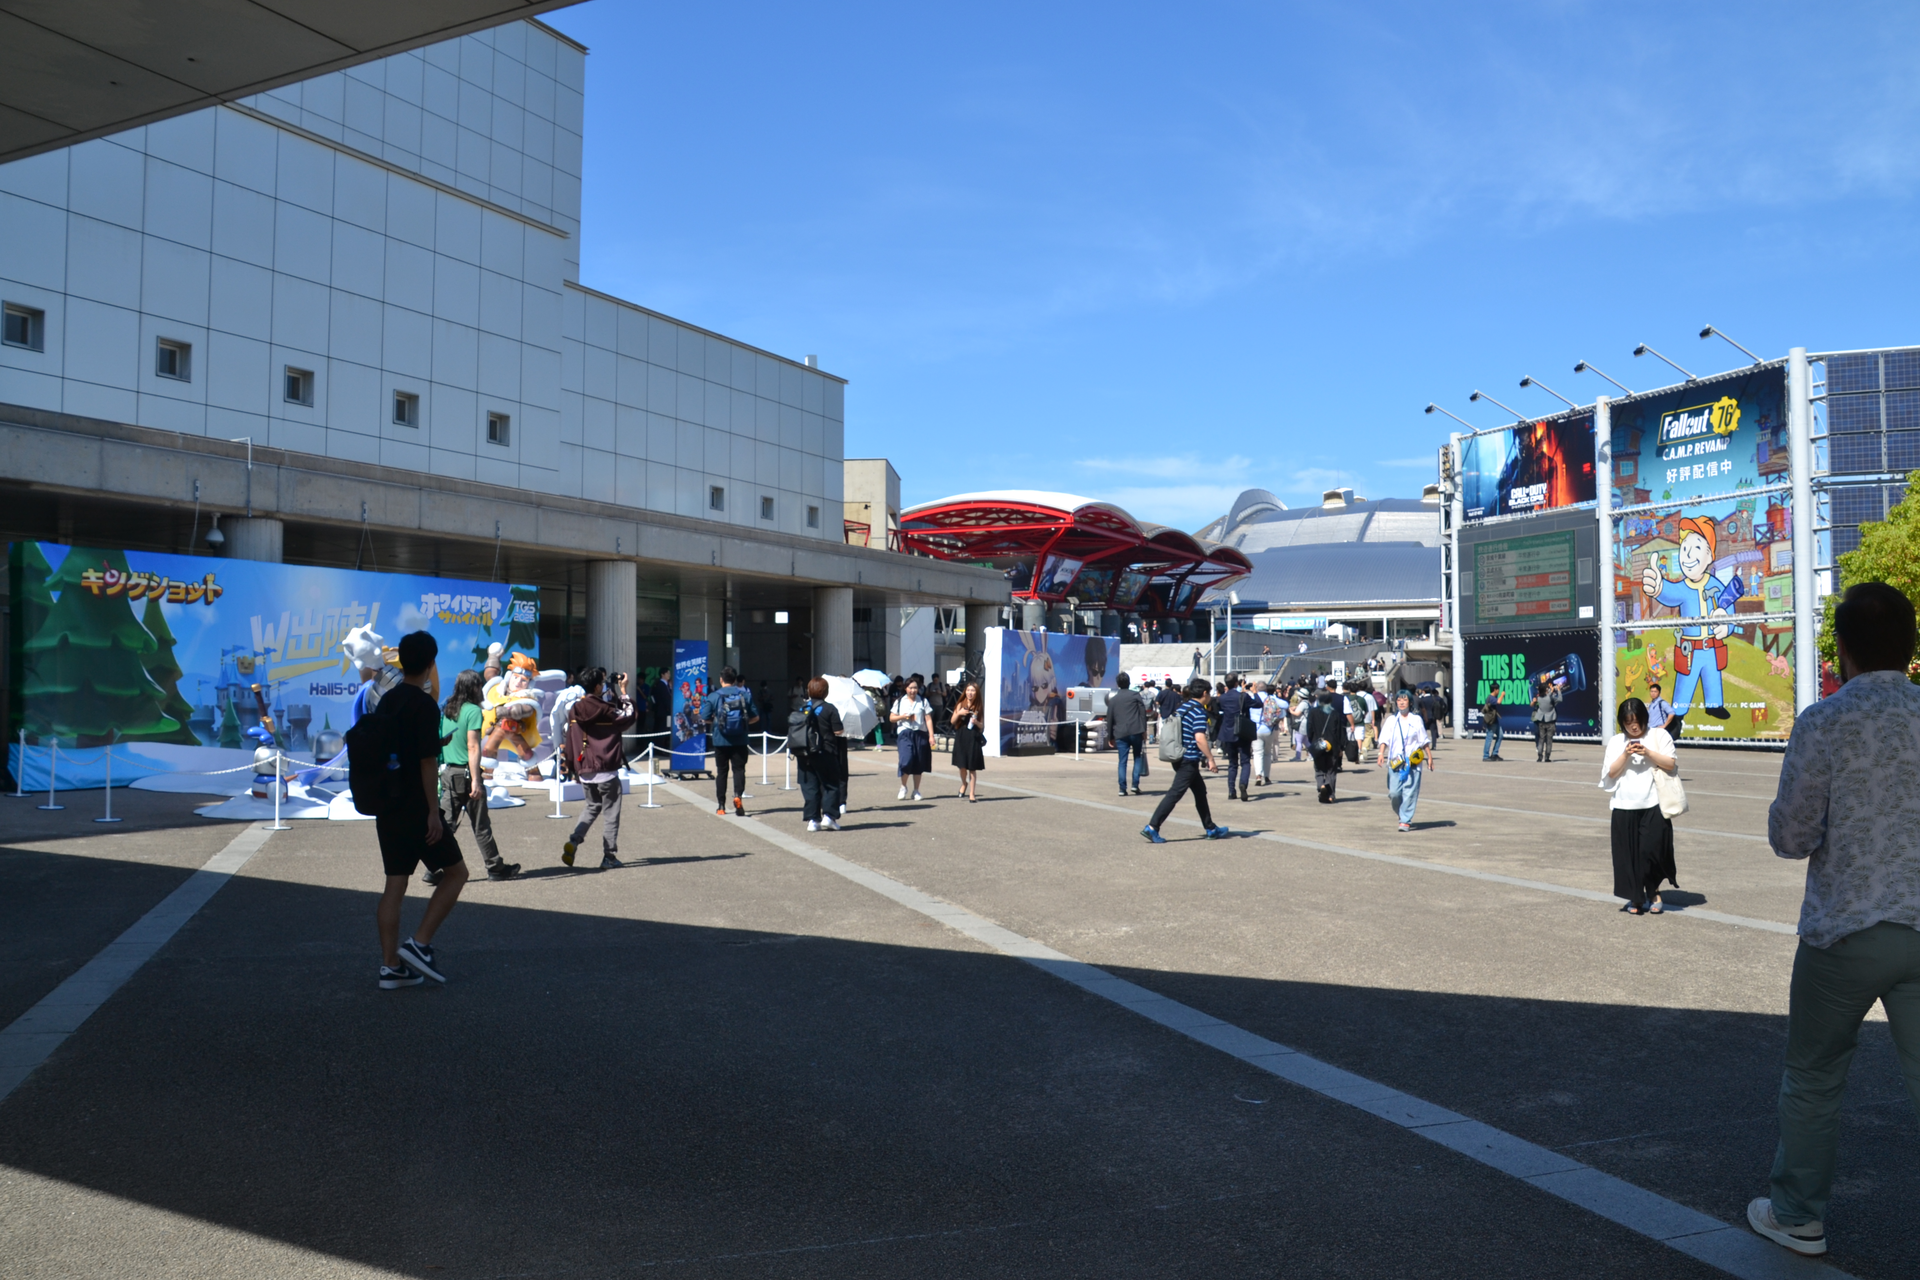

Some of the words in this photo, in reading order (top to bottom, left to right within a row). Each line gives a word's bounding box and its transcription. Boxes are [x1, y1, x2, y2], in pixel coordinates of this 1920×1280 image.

[1662, 408, 1710, 440] Fallout
[1717, 403, 1735, 429] 76
[1662, 444, 1692, 461] C.A.M.P.
[1694, 437, 1730, 456] REVAMP
[1666, 459, 1732, 484] 好評配信中
[1508, 497, 1530, 506] BLACK
[1530, 494, 1544, 502] OPS
[1510, 486, 1527, 500] CALL
[1529, 483, 1548, 496] DUTY
[81, 567, 223, 606] キングショット
[420, 592, 502, 620] ホワイトアウト
[513, 600, 535, 613] TGS
[437, 611, 494, 627] サバイバル
[513, 613, 535, 623] 2025
[685, 664, 707, 677] つなぐ
[1480, 654, 1510, 680] THIS
[1511, 653, 1526, 679] IS
[1749, 701, 1766, 709] GAME
